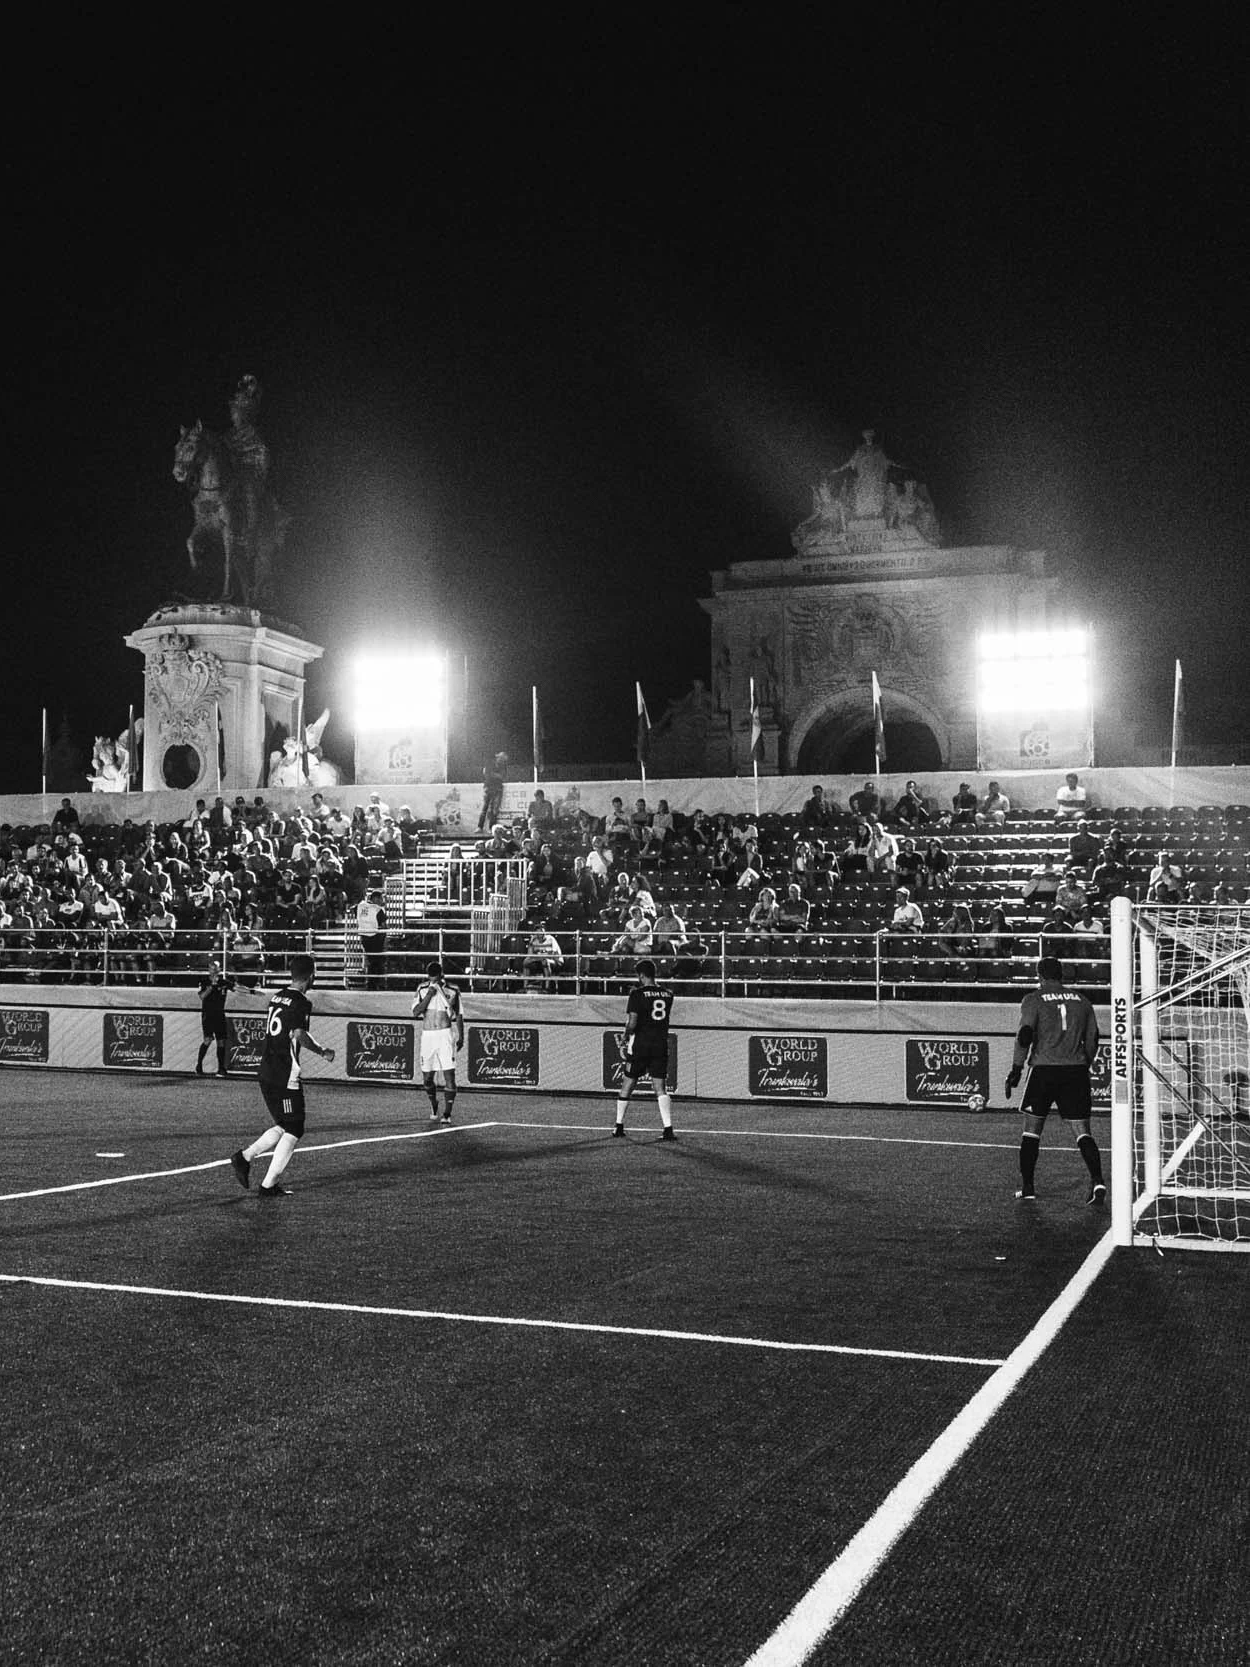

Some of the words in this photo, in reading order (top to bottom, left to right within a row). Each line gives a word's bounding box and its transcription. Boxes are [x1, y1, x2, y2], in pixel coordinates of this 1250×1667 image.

[1041, 992, 1063, 1002] TEAM
[1063, 992, 1082, 1001] USA
[1, 1011, 42, 1024] WORLD
[651, 999, 666, 1020] 8
[1057, 1003, 1068, 1031] 1
[5, 1020, 42, 1035] GROUP
[112, 1015, 156, 1028] WORLD
[232, 1018, 267, 1032] WORL
[266, 1006, 283, 1036] 16
[116, 1024, 156, 1040] GROUP
[237, 1028, 266, 1044] GRO
[357, 1024, 407, 1039] WORLD
[478, 1029, 531, 1044] WORLD
[1115, 998, 1127, 1078] AFFSPORTS
[362, 1034, 407, 1050] GROUP
[484, 1039, 531, 1056] GROUP
[760, 1038, 818, 1053] WORLD
[917, 1042, 979, 1057] WORLD
[766, 1048, 818, 1066] GROUP
[924, 1052, 979, 1071] GROUP
